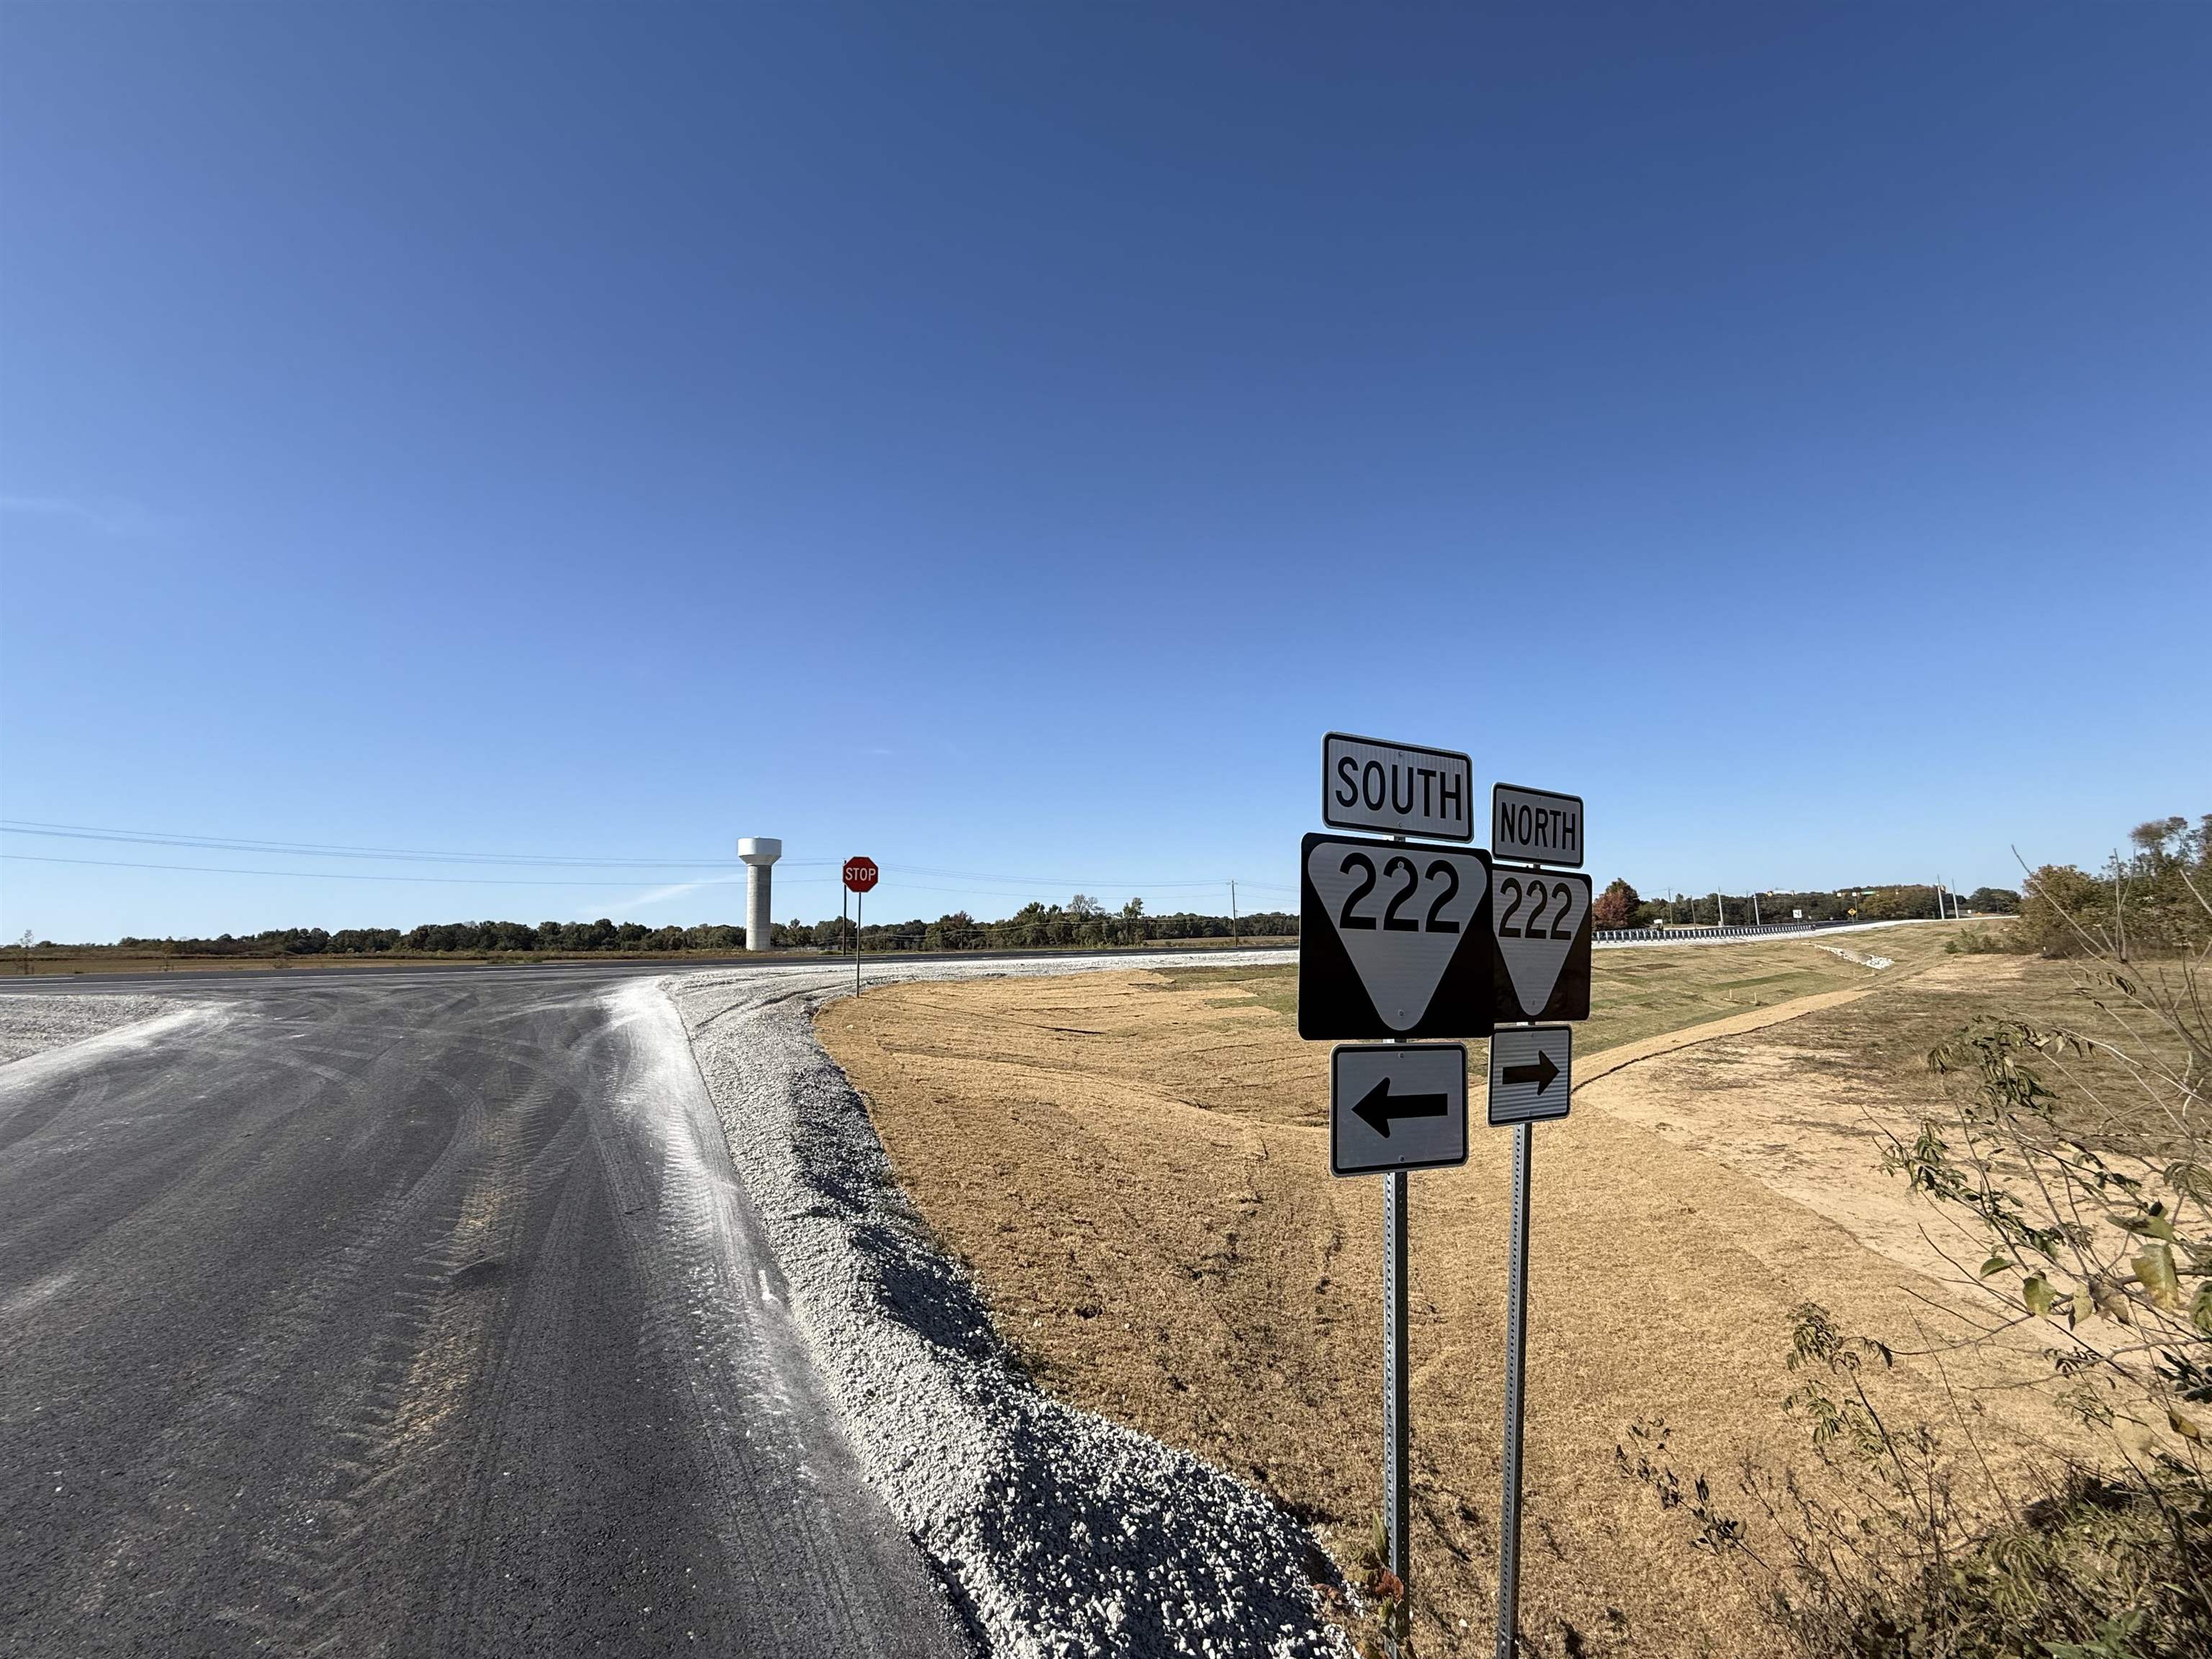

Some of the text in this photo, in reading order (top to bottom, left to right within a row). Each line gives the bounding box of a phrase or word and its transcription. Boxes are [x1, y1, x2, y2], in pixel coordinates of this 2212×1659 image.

[1336, 756, 1461, 821] SOUTH
[1501, 802, 1576, 850] NORTH
[845, 867, 876, 881] STOP
[1339, 852, 1460, 934] 222
[1499, 877, 1572, 940] 222
